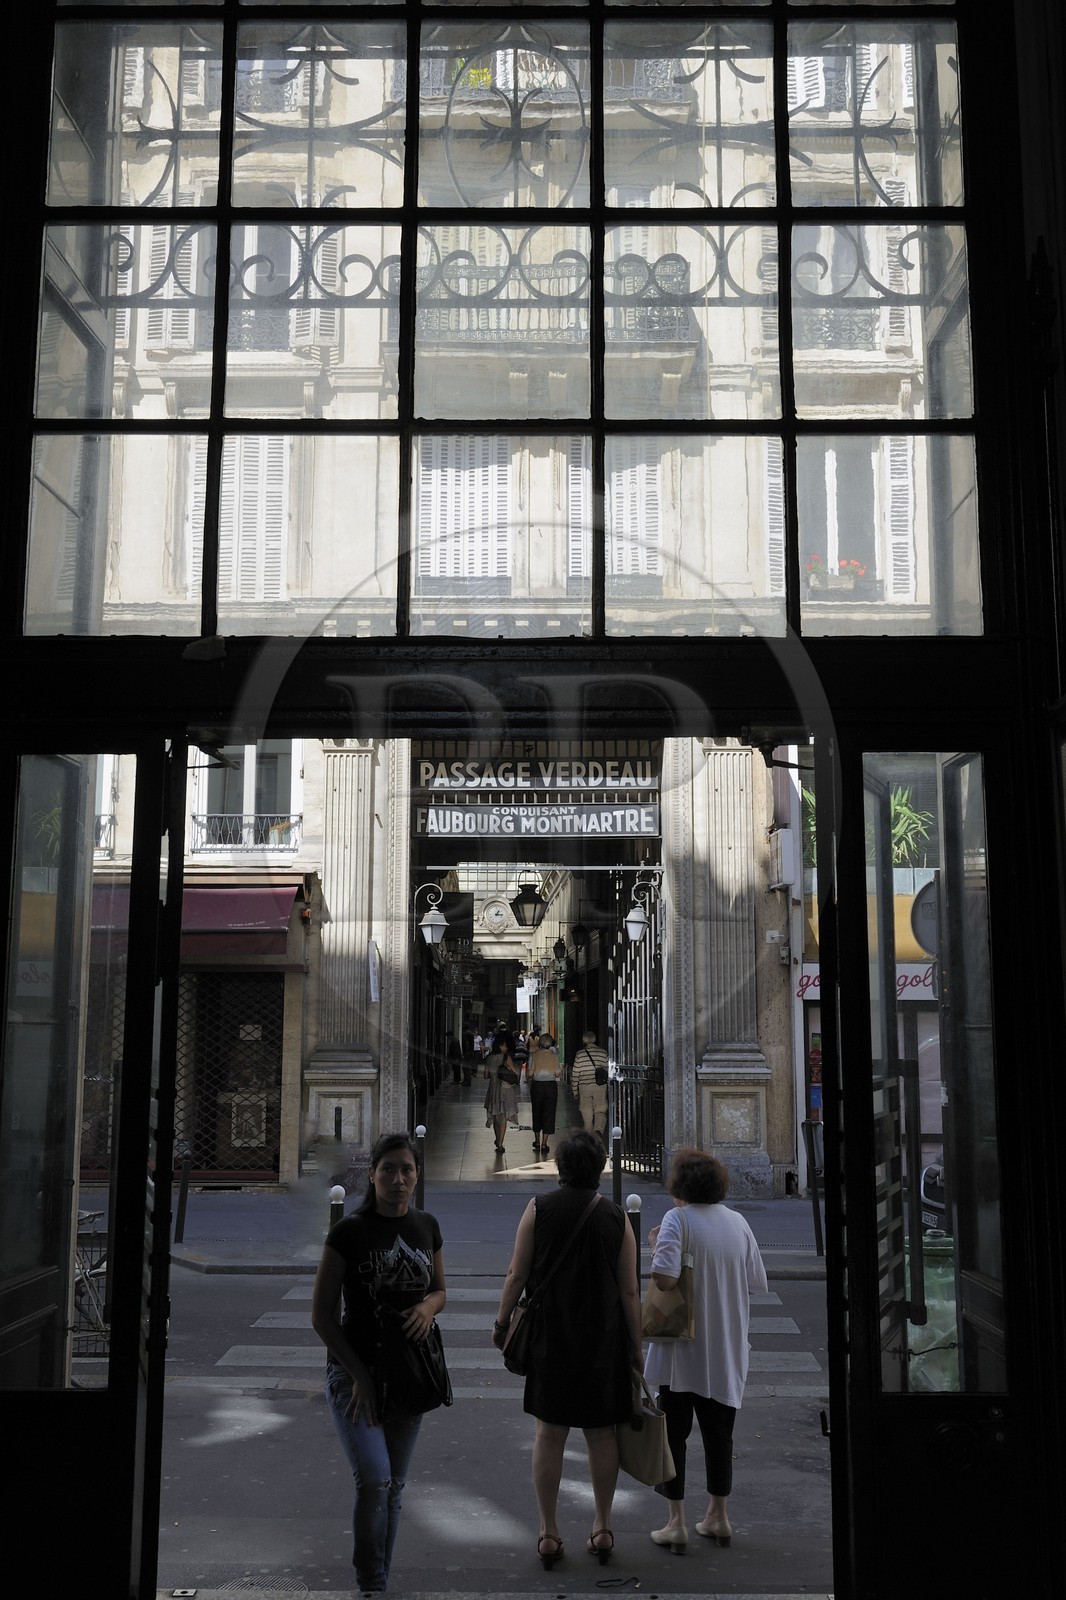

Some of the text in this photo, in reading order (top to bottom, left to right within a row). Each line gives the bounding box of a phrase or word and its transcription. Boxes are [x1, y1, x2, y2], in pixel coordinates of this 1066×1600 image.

[420, 761, 652, 787] PASSAGE VERDEAU
[416, 806, 654, 834] FAUBOURG MONTMARTRE
[492, 806, 577, 817] CONDUISANT
